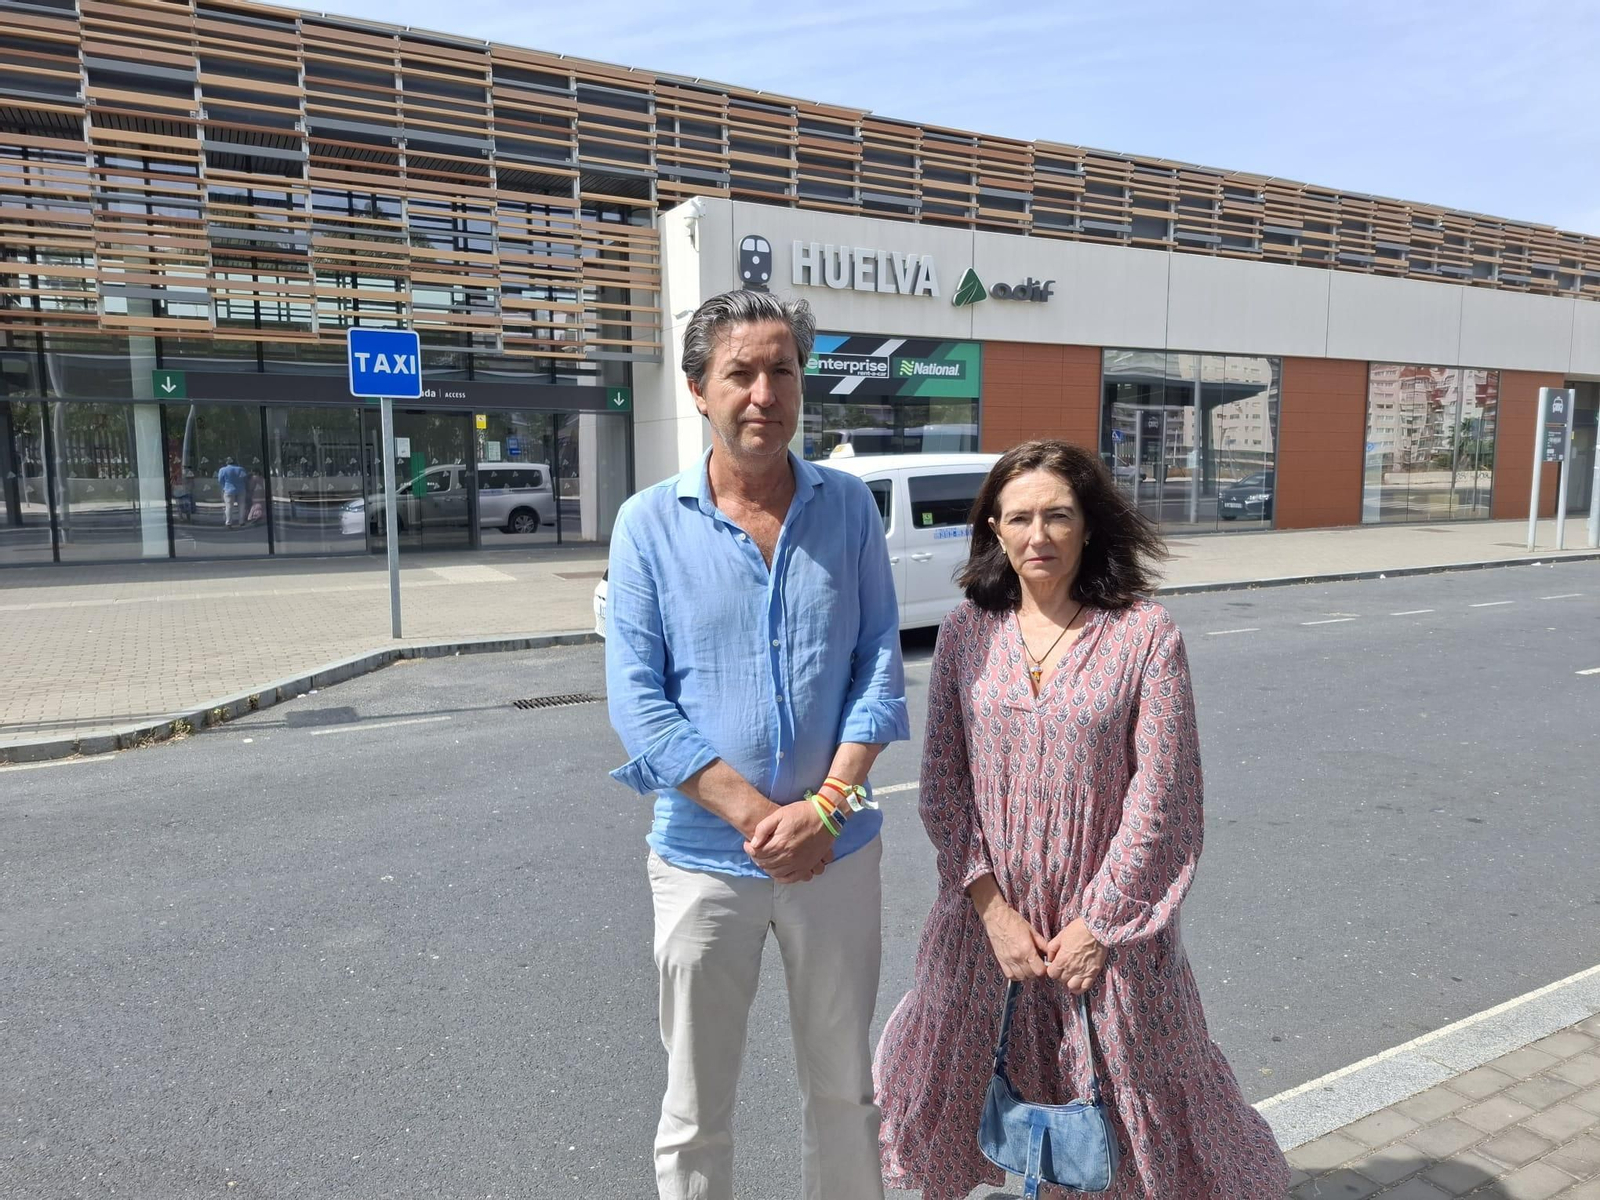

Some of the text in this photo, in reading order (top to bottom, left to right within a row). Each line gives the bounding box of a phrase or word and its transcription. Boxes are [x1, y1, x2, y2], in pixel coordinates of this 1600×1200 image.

[792, 240, 940, 298] HUELVA
[989, 276, 1056, 303] adif
[354, 352, 416, 375] TAXI
[805, 357, 887, 374] enterprise
